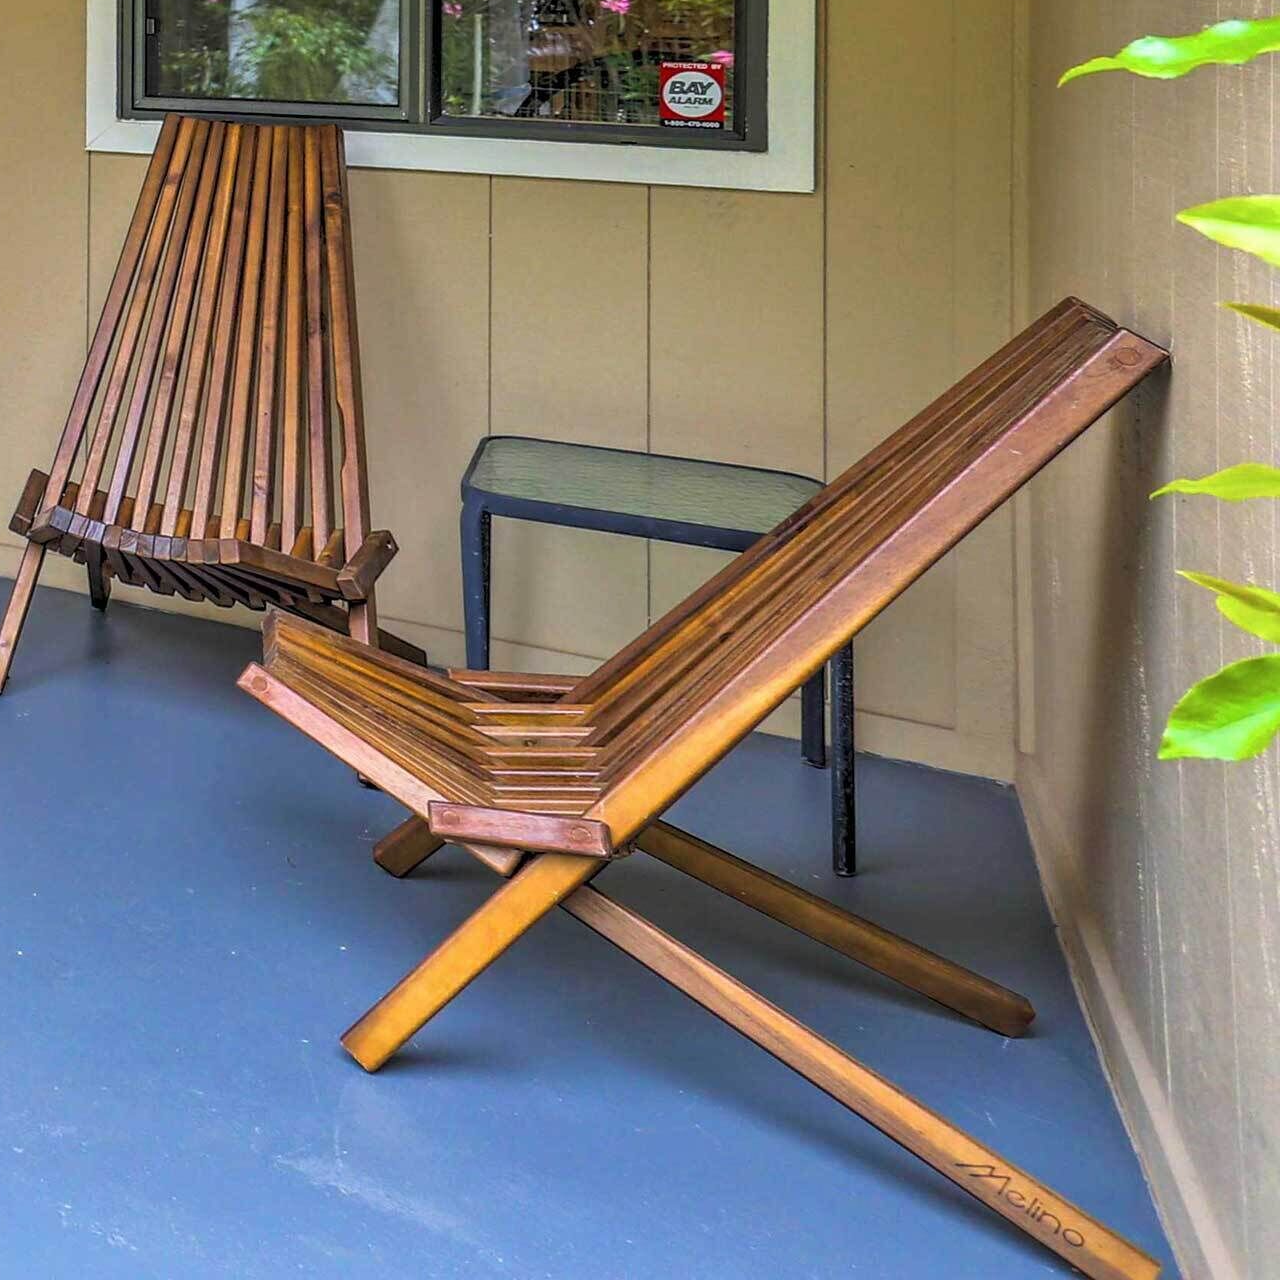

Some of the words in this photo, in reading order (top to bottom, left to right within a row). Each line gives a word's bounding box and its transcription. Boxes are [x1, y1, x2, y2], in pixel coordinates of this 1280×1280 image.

[662, 62, 708, 70] PROTECTED
[668, 80, 715, 96] BAY
[668, 95, 715, 106] ALARM
